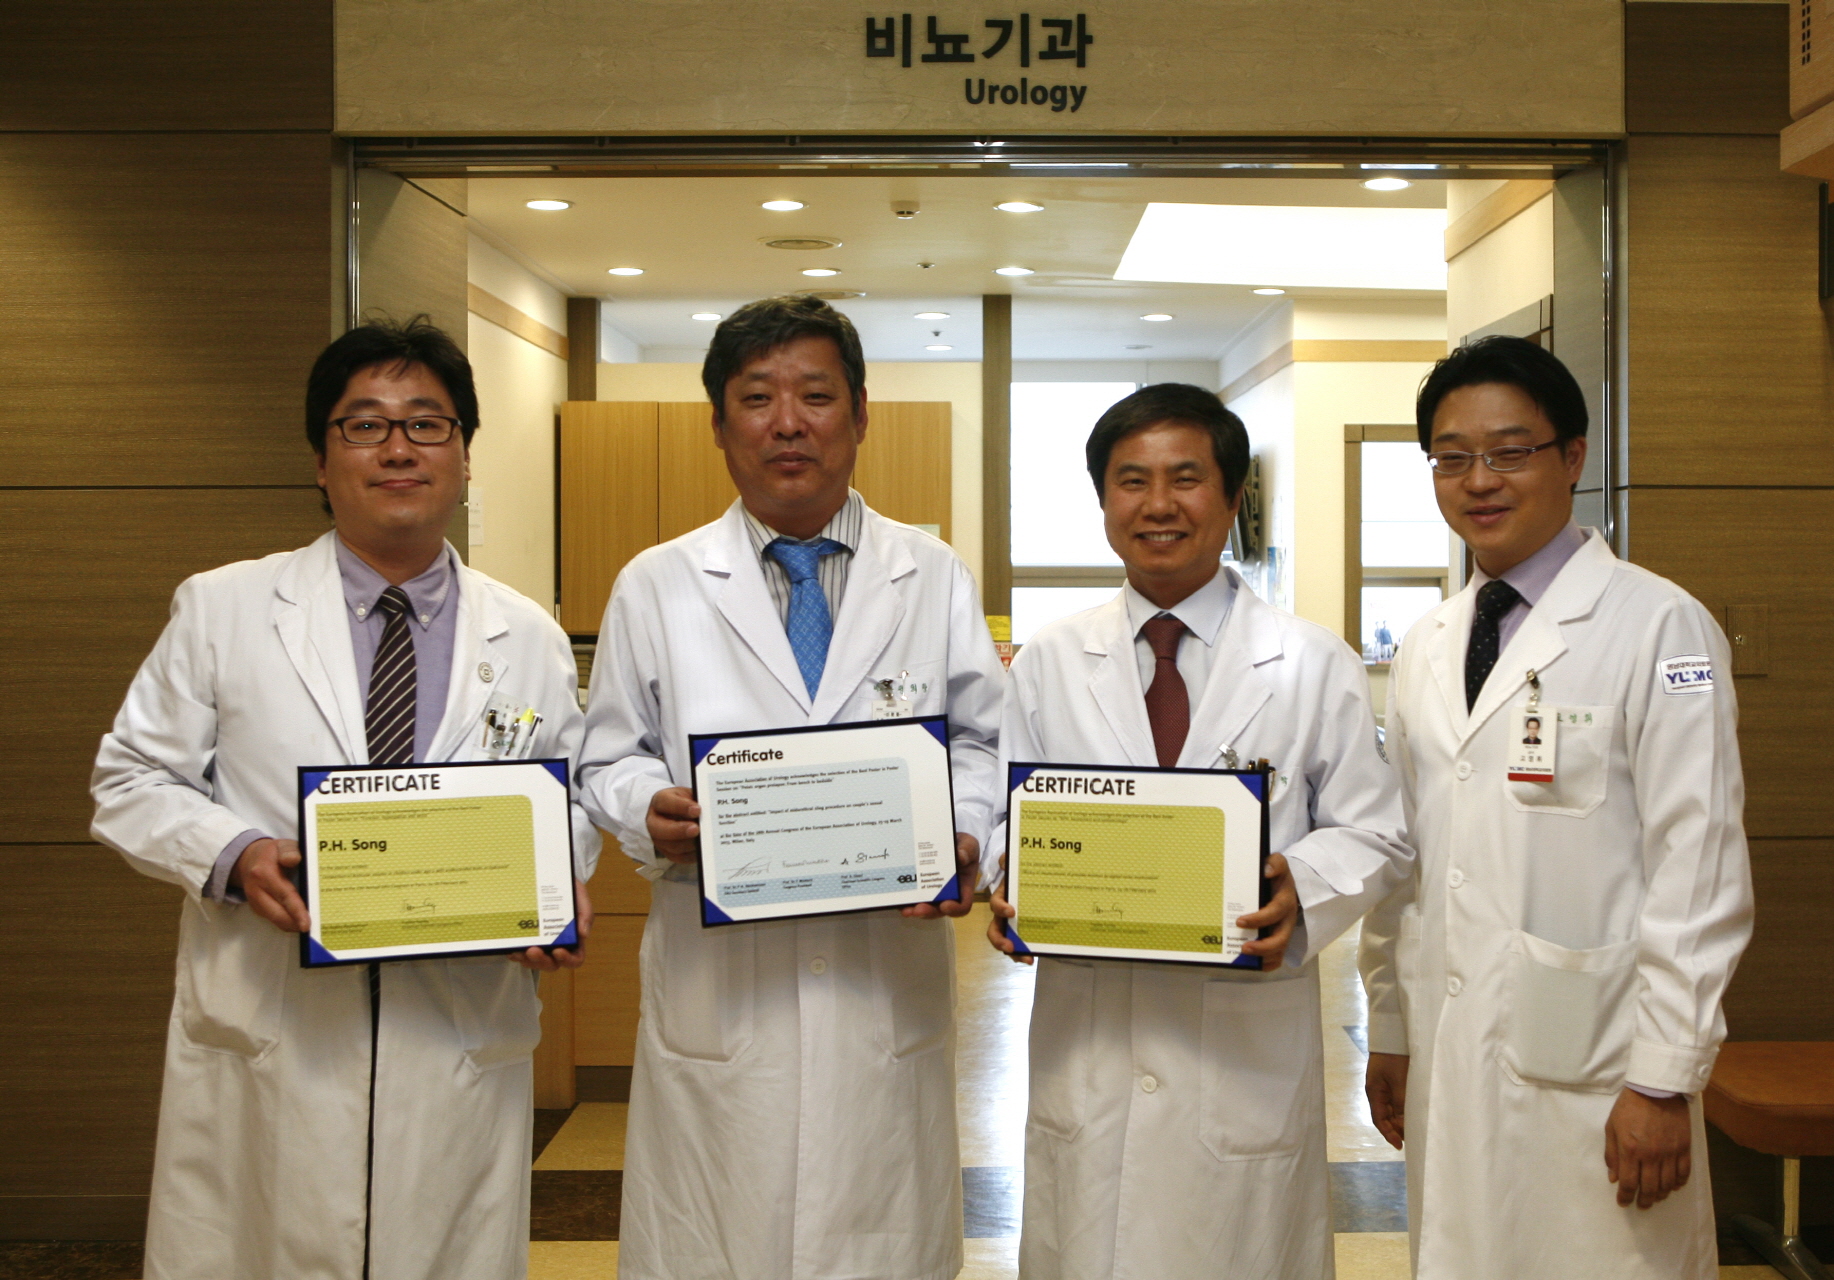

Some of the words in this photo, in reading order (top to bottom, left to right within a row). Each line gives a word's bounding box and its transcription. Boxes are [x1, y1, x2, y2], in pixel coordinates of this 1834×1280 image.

[866, 13, 1093, 67] 비뇨기과
[965, 77, 1087, 113] Urology
[706, 748, 784, 766] Certificate
[317, 773, 440, 794] CERTIFICATE
[1022, 775, 1136, 795] CERTIFICATE
[319, 840, 347, 852] P.H.
[352, 839, 387, 852] Song
[1021, 837, 1045, 849] P.H.
[1050, 838, 1082, 853] Song
